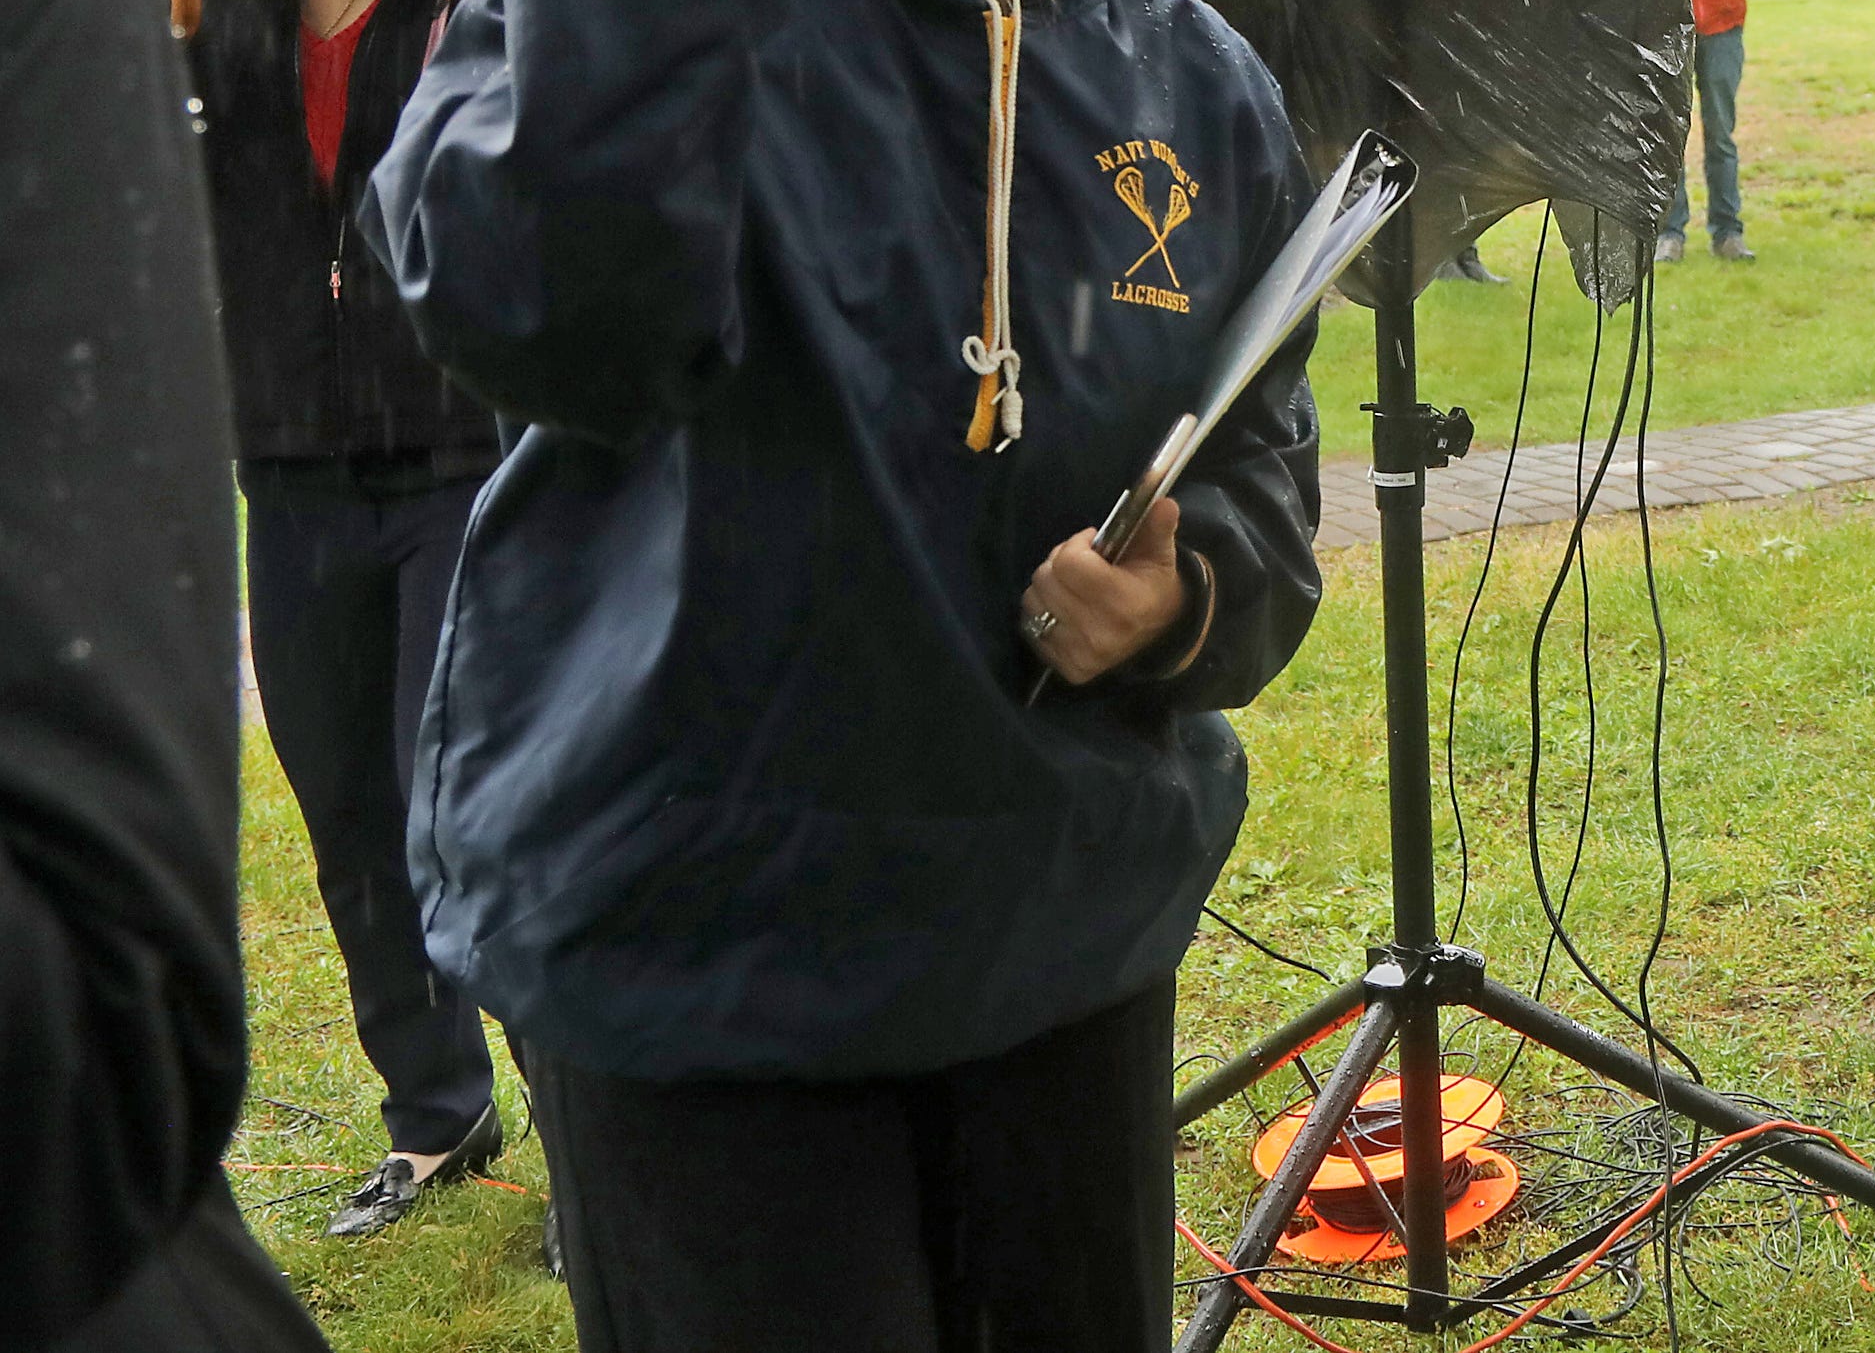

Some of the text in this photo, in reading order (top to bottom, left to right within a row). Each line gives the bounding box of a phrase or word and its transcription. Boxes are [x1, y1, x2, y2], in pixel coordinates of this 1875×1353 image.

[1094, 139, 1201, 198] NAVY WOMEN'S
[1111, 281, 1191, 314] LACROSSE
